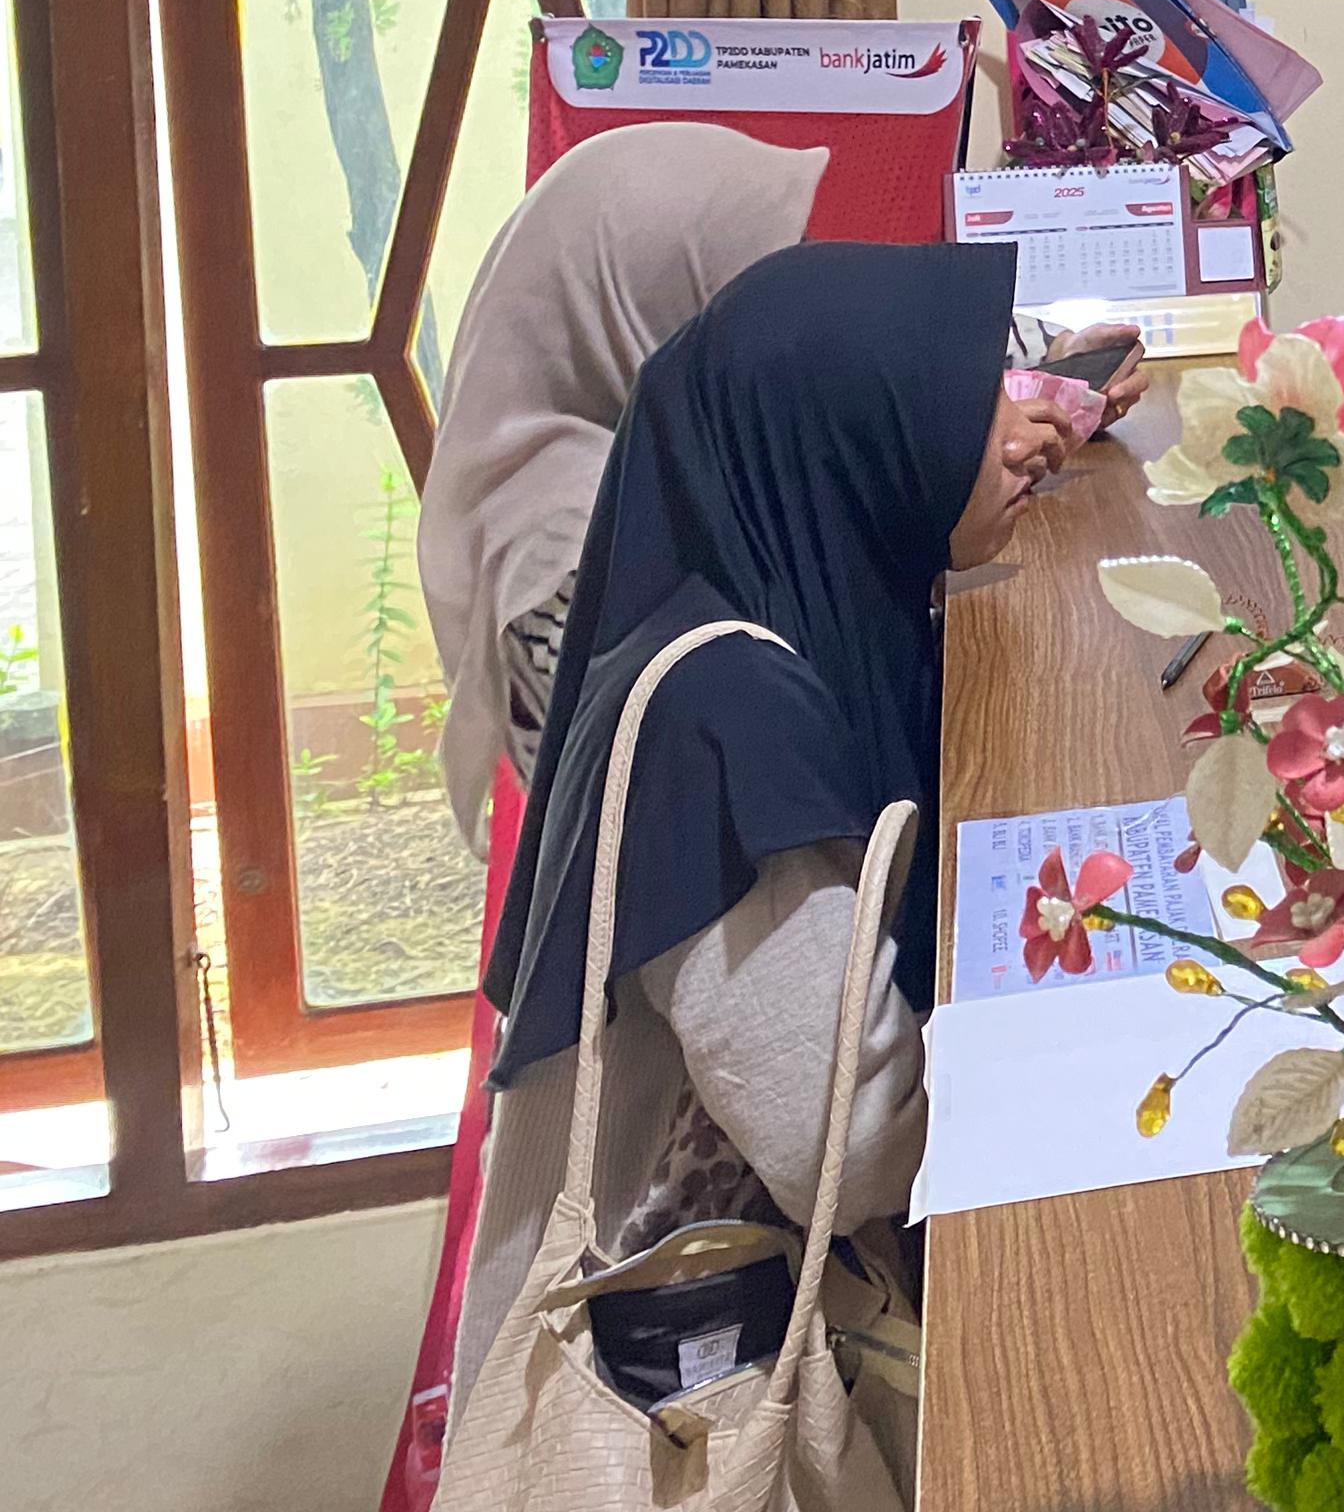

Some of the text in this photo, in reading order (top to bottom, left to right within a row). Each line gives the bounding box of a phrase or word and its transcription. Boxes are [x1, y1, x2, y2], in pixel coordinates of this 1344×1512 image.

[716, 46, 810, 56] TP2DD KABUPATEN
[717, 60, 777, 69] PAMEKASAN
[1054, 187, 1085, 198] 2025
[1132, 884, 1165, 961] PAMESAN
